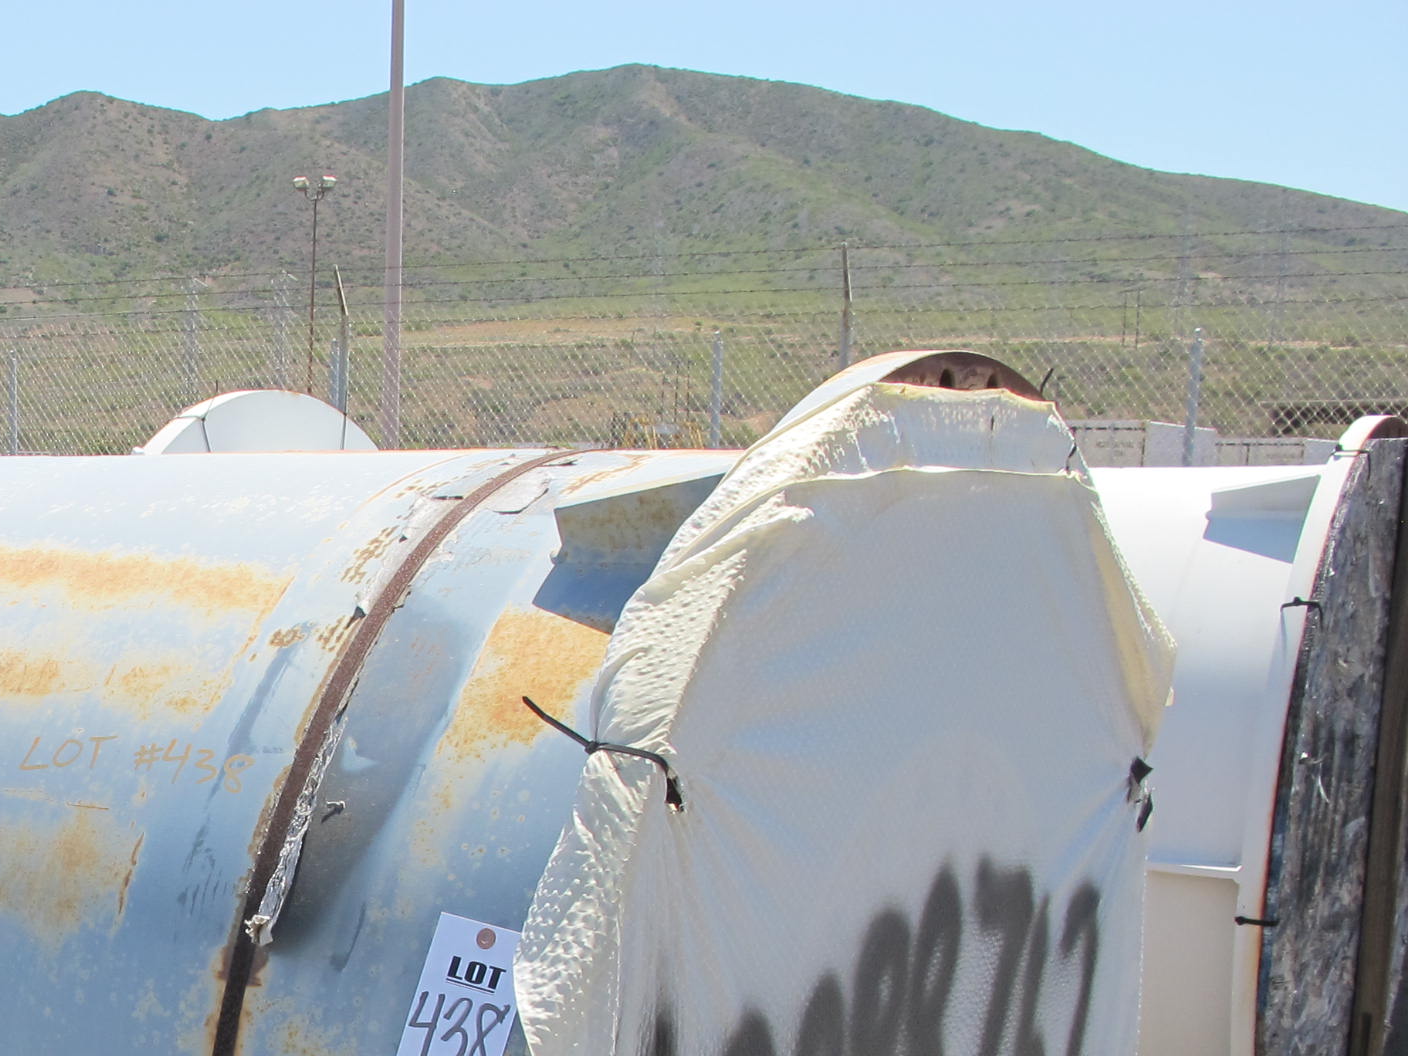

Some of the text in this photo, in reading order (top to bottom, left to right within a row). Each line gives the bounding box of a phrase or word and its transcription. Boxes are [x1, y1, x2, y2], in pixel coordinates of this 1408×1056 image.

[19, 735, 255, 793] LOT #438
[446, 956, 506, 991] LOT
